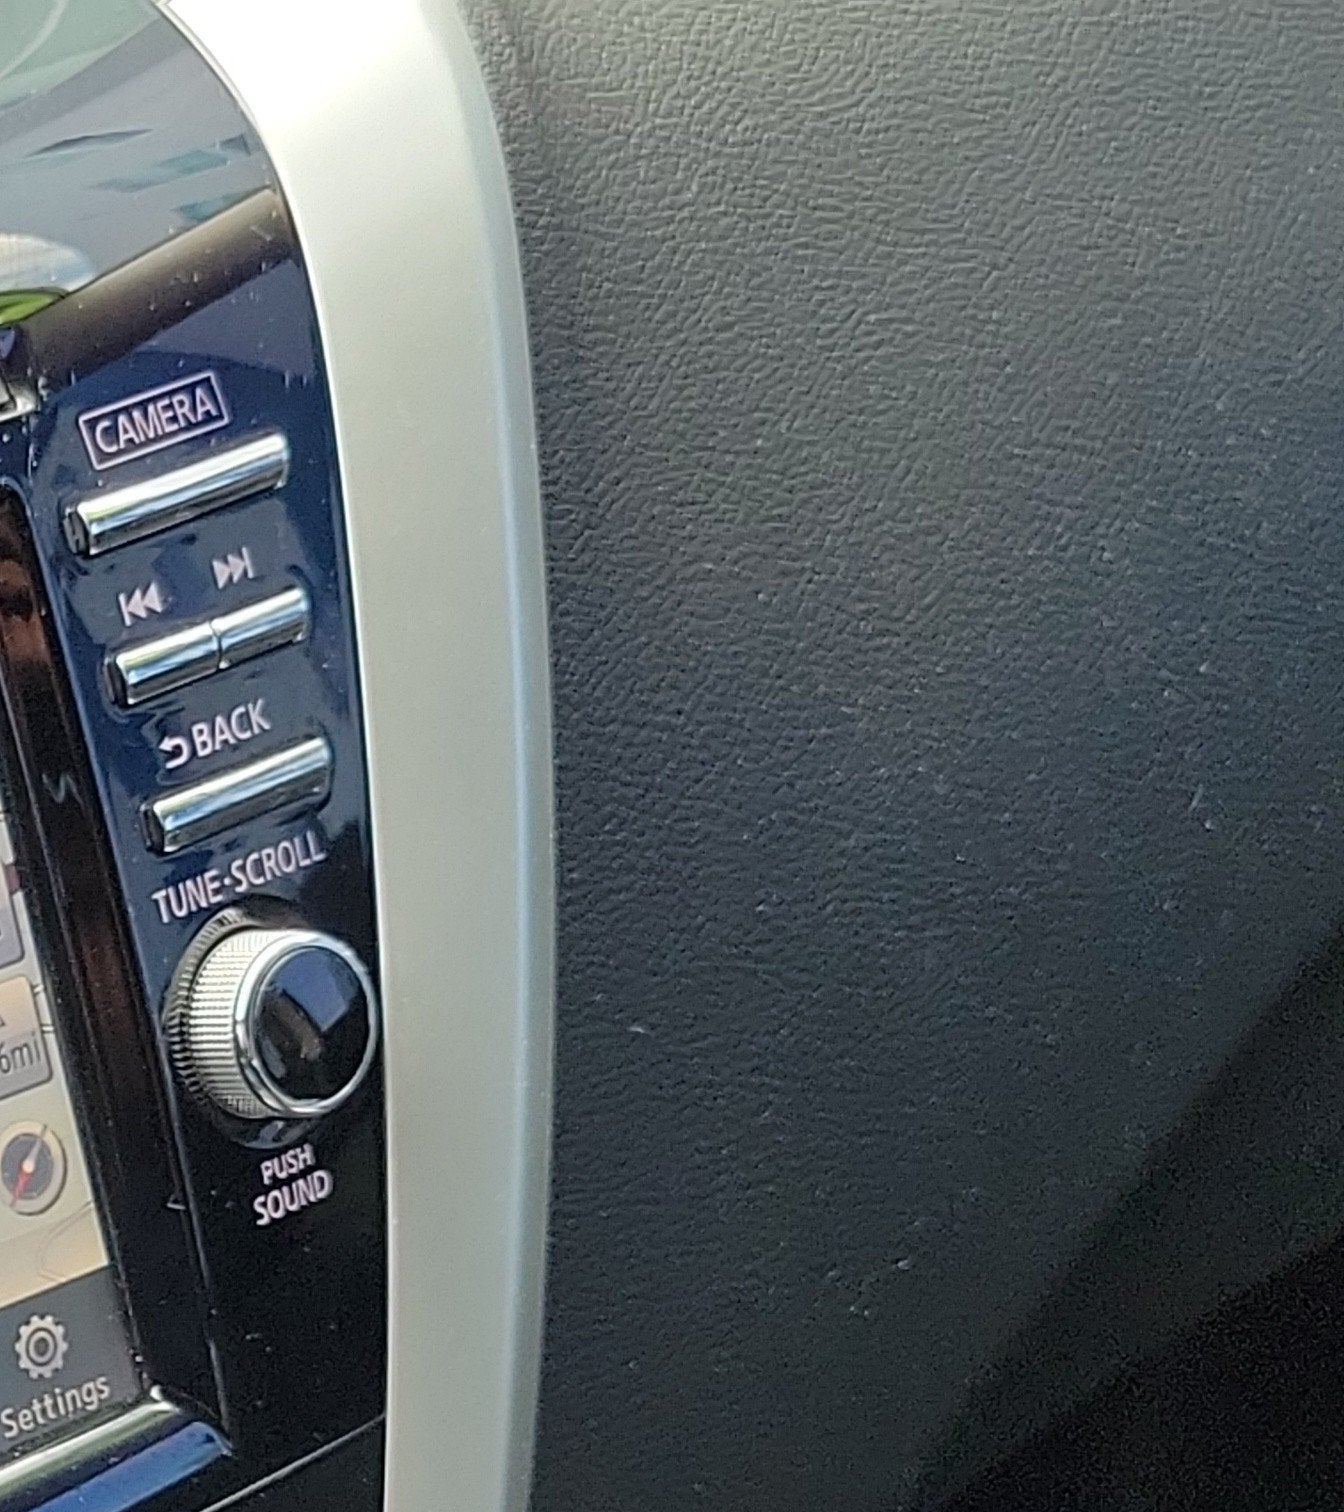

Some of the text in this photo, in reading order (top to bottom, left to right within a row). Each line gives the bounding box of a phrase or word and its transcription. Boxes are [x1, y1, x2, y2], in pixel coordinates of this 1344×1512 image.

[93, 389, 218, 456] CAMERA
[190, 699, 272, 760] BACK
[259, 1143, 313, 1186] PUSH
[253, 1169, 334, 1227] SOUND
[0, 1374, 111, 1440] Settings
